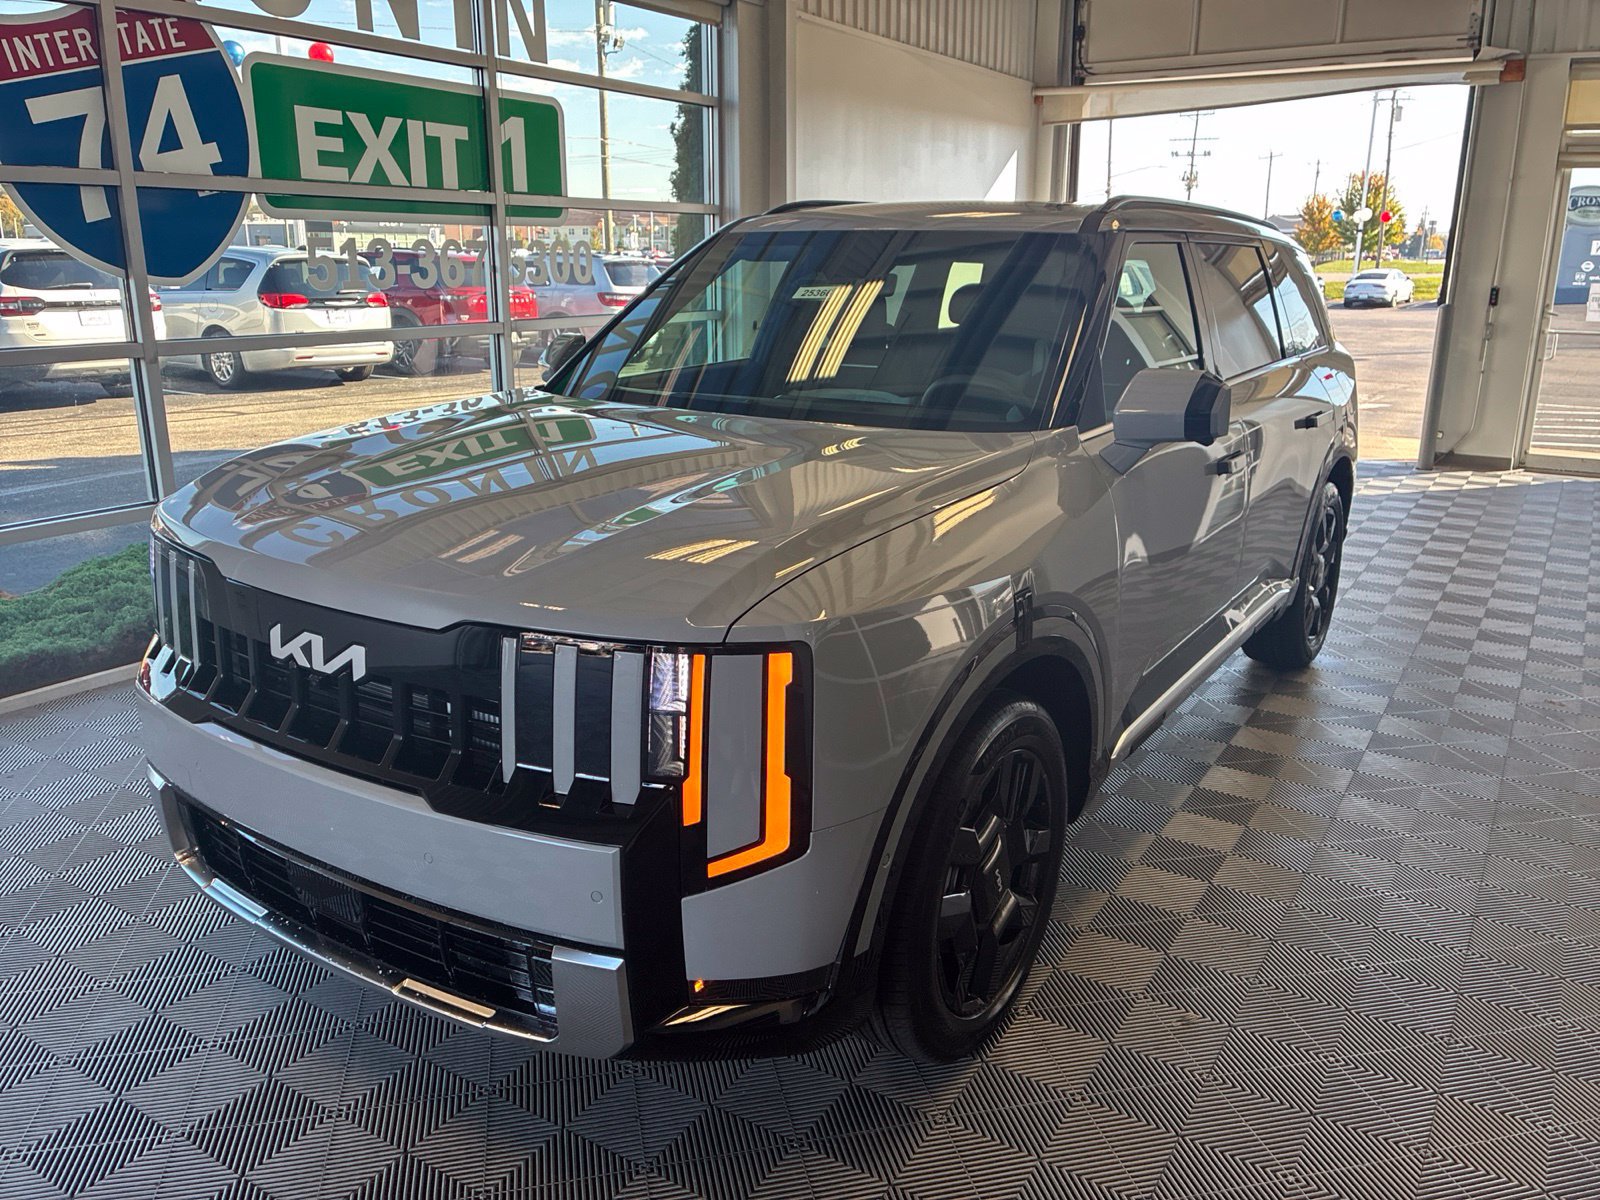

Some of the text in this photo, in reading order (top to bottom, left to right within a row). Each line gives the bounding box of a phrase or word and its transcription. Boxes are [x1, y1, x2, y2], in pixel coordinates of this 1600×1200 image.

[1, 17, 187, 73] INTERTATE
[24, 74, 223, 223] 74
[293, 104, 529, 192] EXIT 1
[1568, 195, 1600, 211] CRO
[306, 236, 593, 292] 513-3675300
